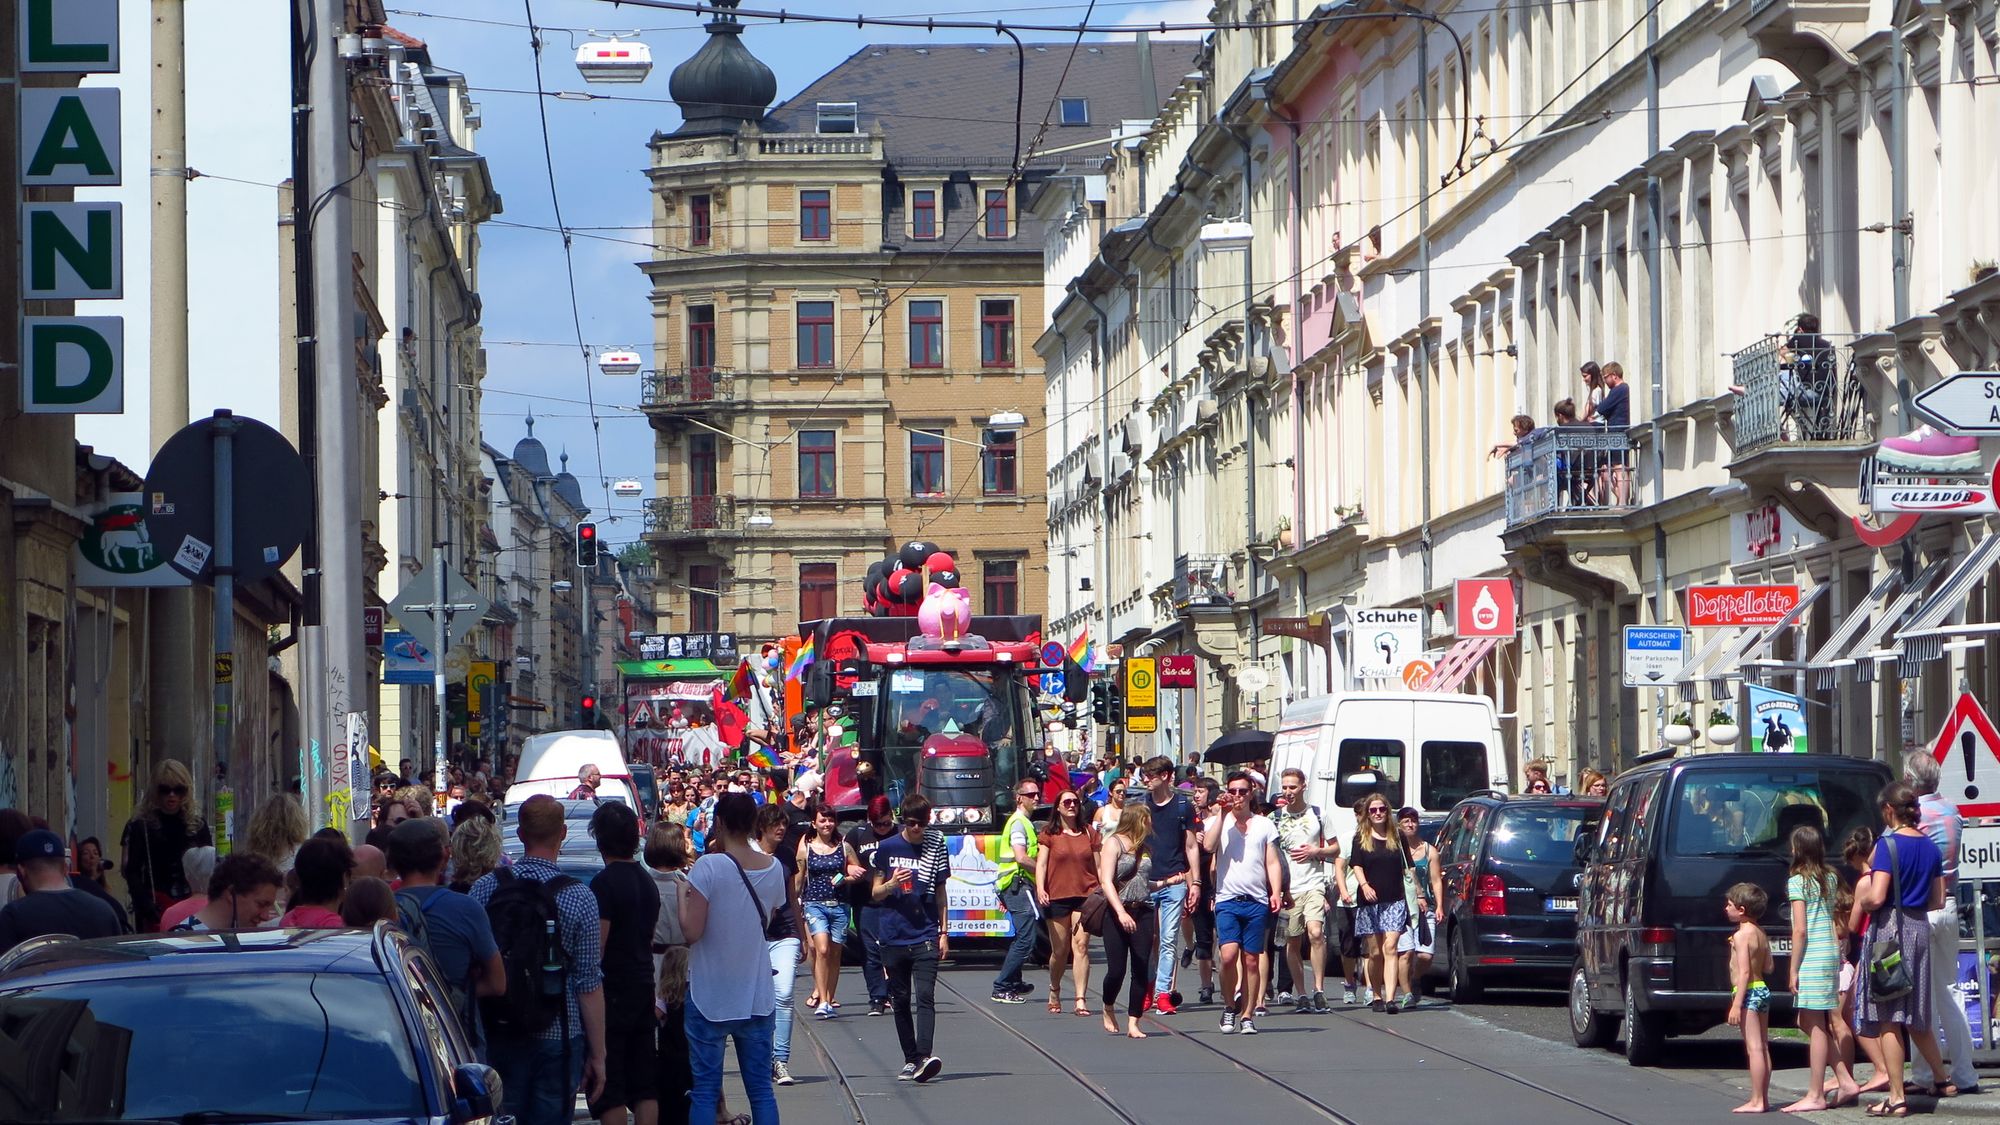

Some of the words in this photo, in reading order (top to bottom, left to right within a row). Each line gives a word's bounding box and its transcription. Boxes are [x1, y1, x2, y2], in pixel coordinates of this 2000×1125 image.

[1692, 591, 1793, 622] Doppellotte
[1357, 611, 1418, 623] Schuhe
[1629, 631, 1679, 640] PARKSCHEIN-
[1637, 640, 1671, 648] AUTOMAT
[1960, 842, 2000, 869] lspli
